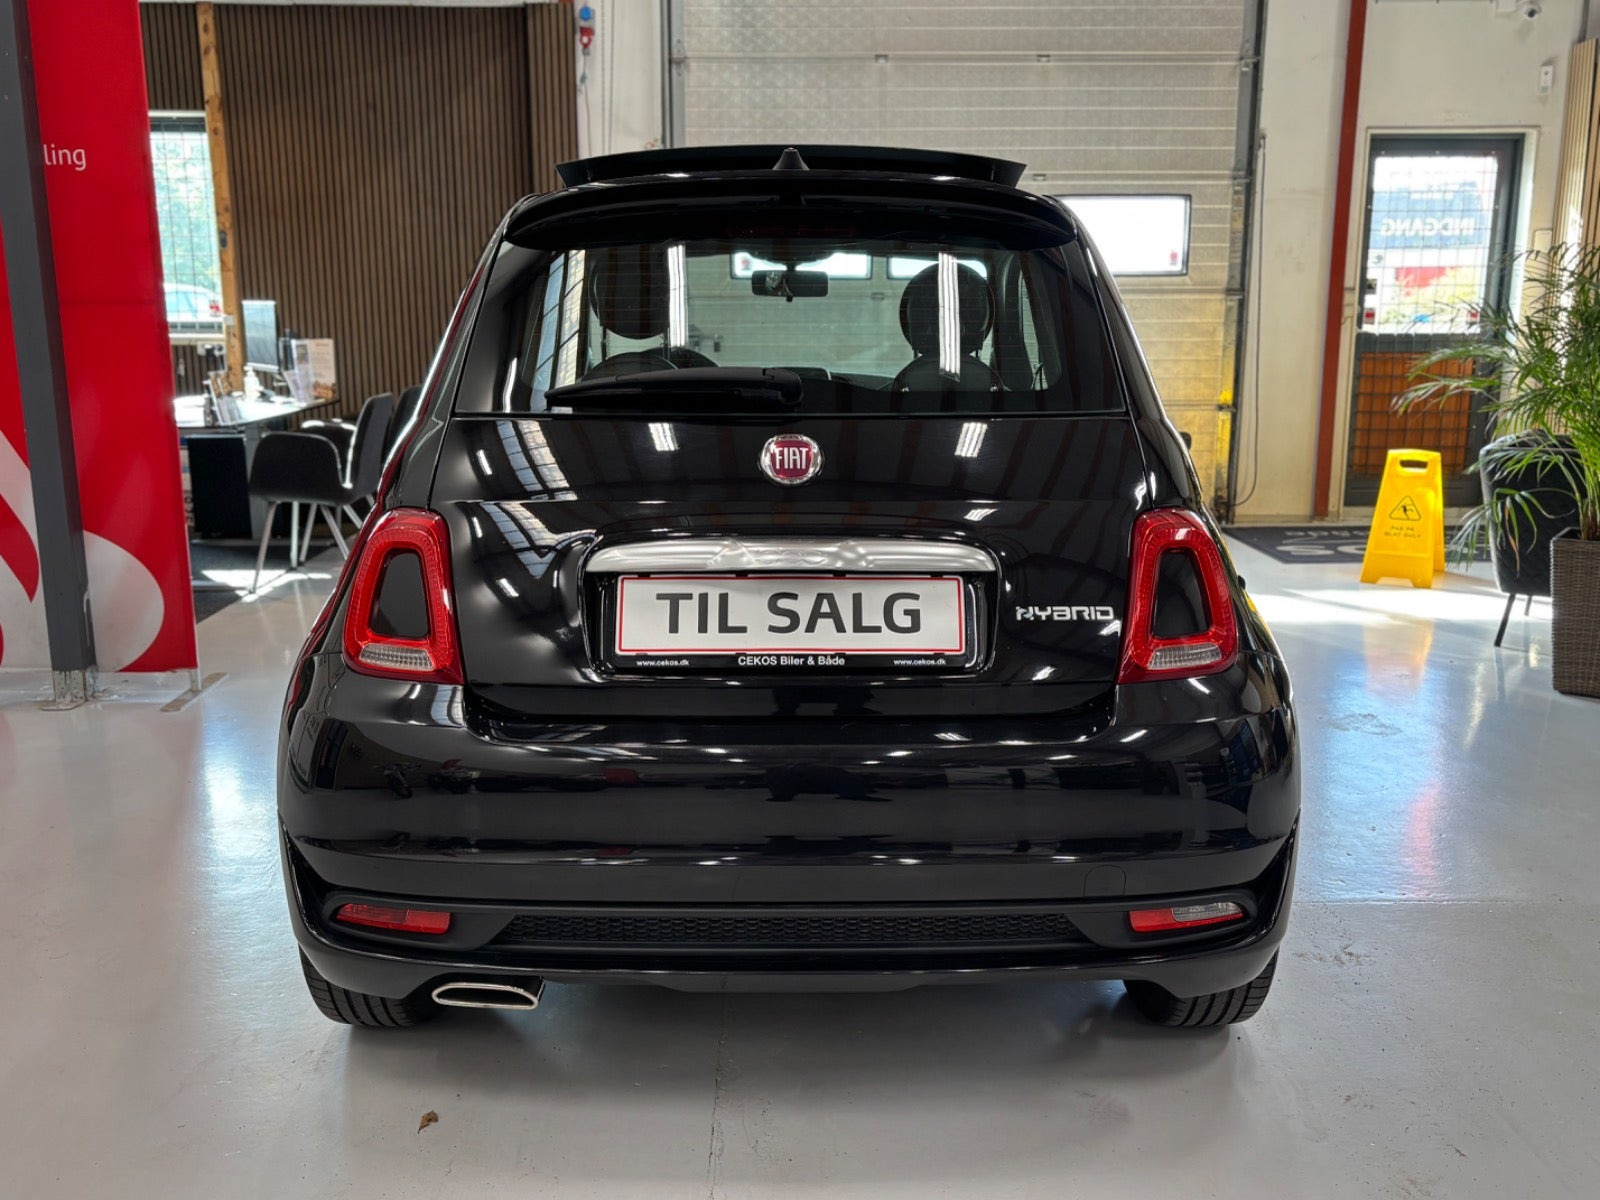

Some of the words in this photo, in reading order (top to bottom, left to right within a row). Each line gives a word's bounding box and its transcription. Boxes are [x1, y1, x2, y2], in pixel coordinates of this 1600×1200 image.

[43, 143, 87, 171] ling
[775, 447, 809, 470] FIAT
[656, 592, 748, 634] TIL
[767, 592, 921, 635] SALG
[1016, 606, 1115, 621] HYBRID
[636, 659, 690, 667] www.cekos.dk
[737, 655, 778, 666] CEKOS
[780, 655, 805, 666] Biler
[807, 655, 815, 666] &
[818, 655, 846, 666] Både
[893, 658, 947, 666] www.cekos.dk
